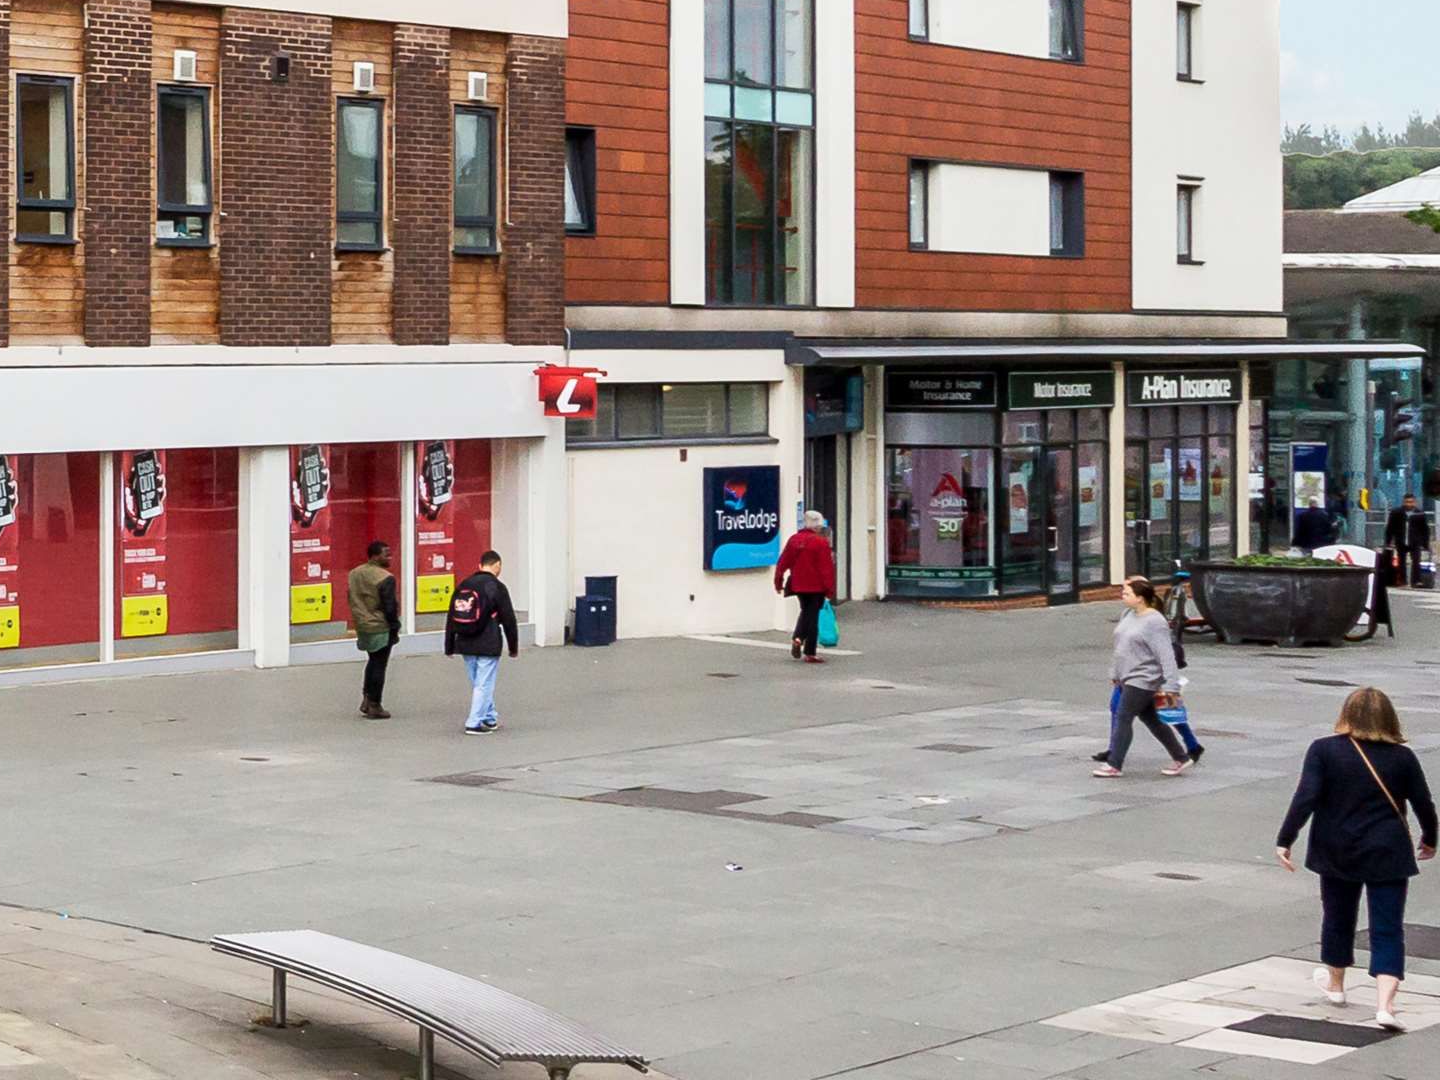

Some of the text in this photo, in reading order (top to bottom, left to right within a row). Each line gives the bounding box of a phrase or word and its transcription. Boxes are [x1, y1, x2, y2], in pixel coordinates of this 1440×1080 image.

[909, 380, 941, 389] Motor
[955, 380, 982, 389] Home
[1033, 382, 1092, 398] Motor Insurance
[1141, 375, 1232, 399] A-Plan Insurance
[923, 391, 973, 400] Insurance
[137, 459, 155, 475] CASH
[432, 462, 445, 481] OUT
[139, 473, 155, 493] OUT
[306, 466, 320, 487] OUT
[715, 508, 777, 533] Travelodge
[939, 520, 958, 533] 50
